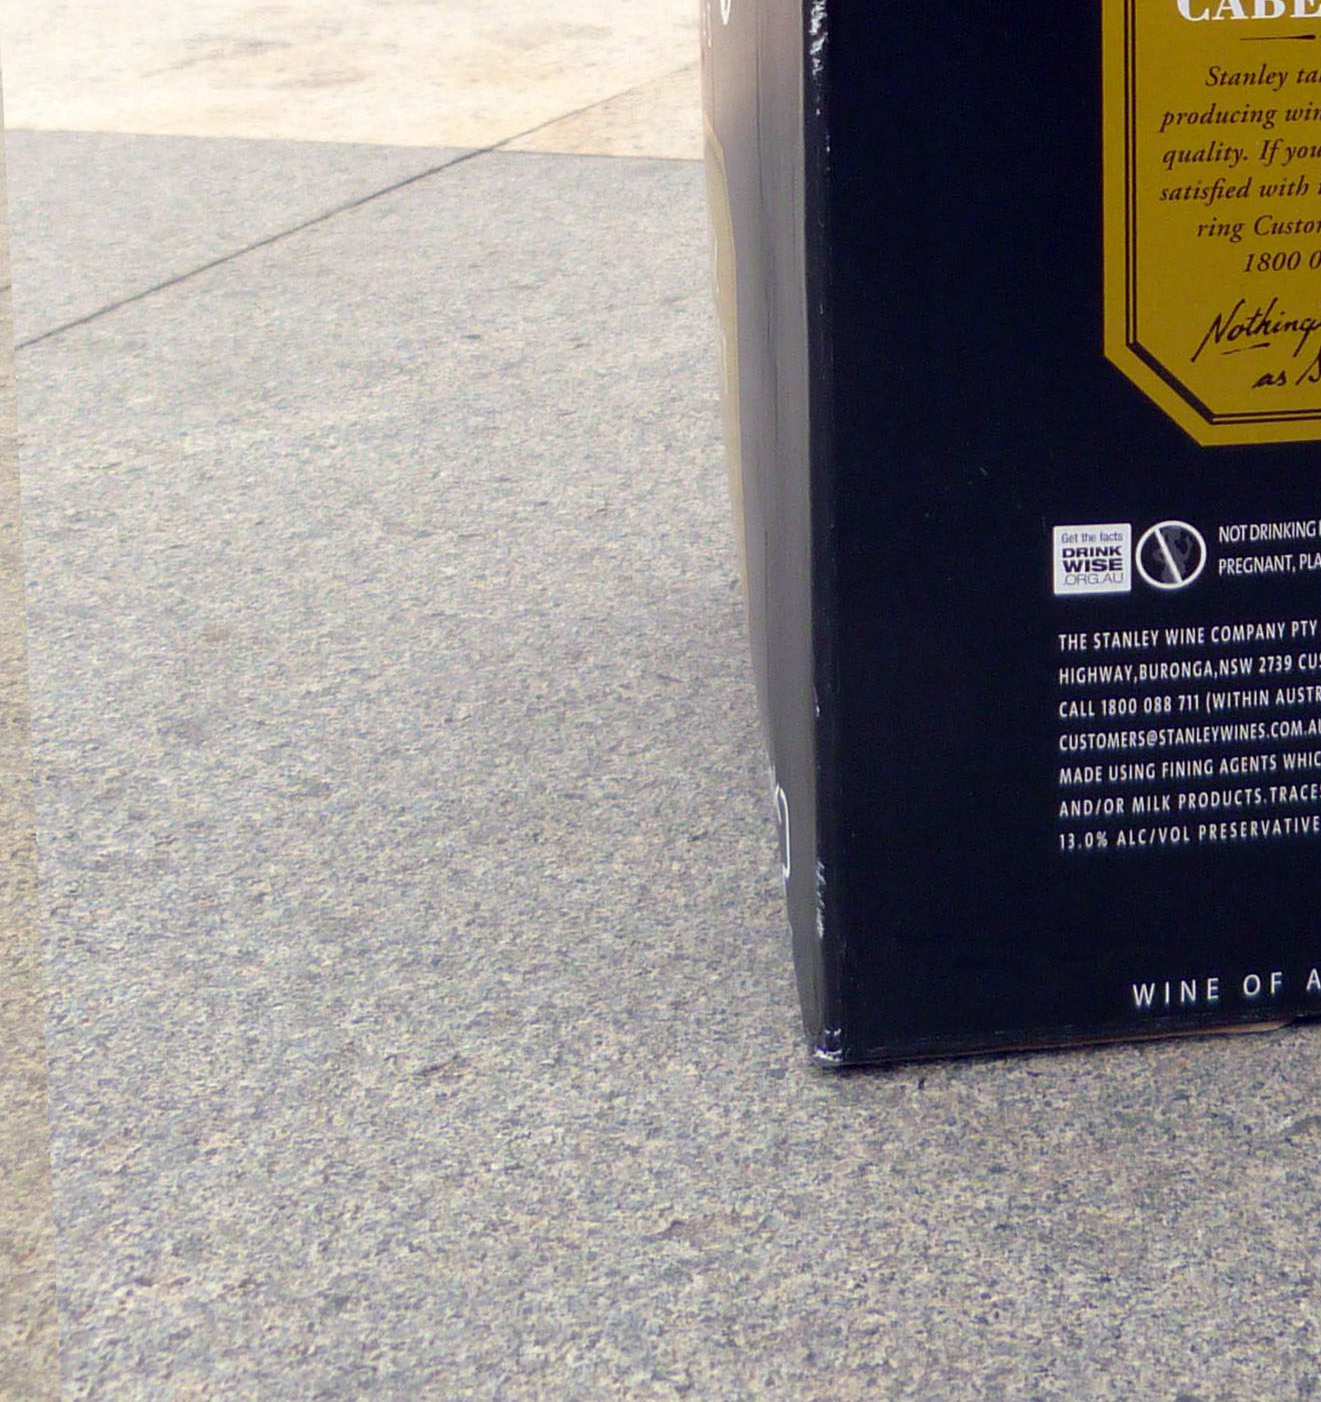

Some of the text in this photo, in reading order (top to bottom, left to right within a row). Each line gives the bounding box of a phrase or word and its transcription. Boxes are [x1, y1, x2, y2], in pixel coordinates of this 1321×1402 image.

[1205, 63, 1288, 92] Stanley
[1159, 102, 1278, 133] producing
[1162, 140, 1248, 171] quality.
[1259, 138, 1284, 167] If
[1159, 175, 1252, 206] satisfied
[1259, 174, 1310, 198] with
[1197, 217, 1246, 243] ring
[1244, 251, 1301, 272] 1800
[1251, 369, 1288, 389] as
[1061, 530, 1124, 545] Get the facts
[1219, 524, 1248, 544] NOT
[1250, 520, 1317, 541] DRINKING
[1062, 545, 1123, 559] DRINK
[1219, 554, 1296, 576] PREGNANT,
[1062, 558, 1123, 574] WISE
[1059, 632, 1088, 652] THE
[1094, 629, 1160, 649] STANLEY
[1165, 626, 1205, 647] WINE
[1211, 621, 1286, 644] COMPANY
[1291, 618, 1319, 638] PTY
[1258, 654, 1293, 674] 2739
[1059, 700, 1096, 719] CALL
[1100, 697, 1138, 717] 1800
[1143, 695, 1172, 714] 088
[1178, 693, 1200, 713] 711
[1205, 689, 1270, 714] (WITHIN
[1059, 766, 1102, 785] MADE
[1109, 762, 1156, 782] USING
[1162, 759, 1214, 779] FINING
[1219, 754, 1277, 775] AGENTS
[1059, 797, 1125, 818] AND/OR
[1132, 795, 1170, 814] MILK
[1059, 830, 1108, 850] 13.0%
[1116, 825, 1190, 848] ALC/VOL
[1198, 814, 1320, 842] PRESERVATIVE
[1133, 977, 1219, 1008] WINE
[1242, 971, 1283, 998] OF
